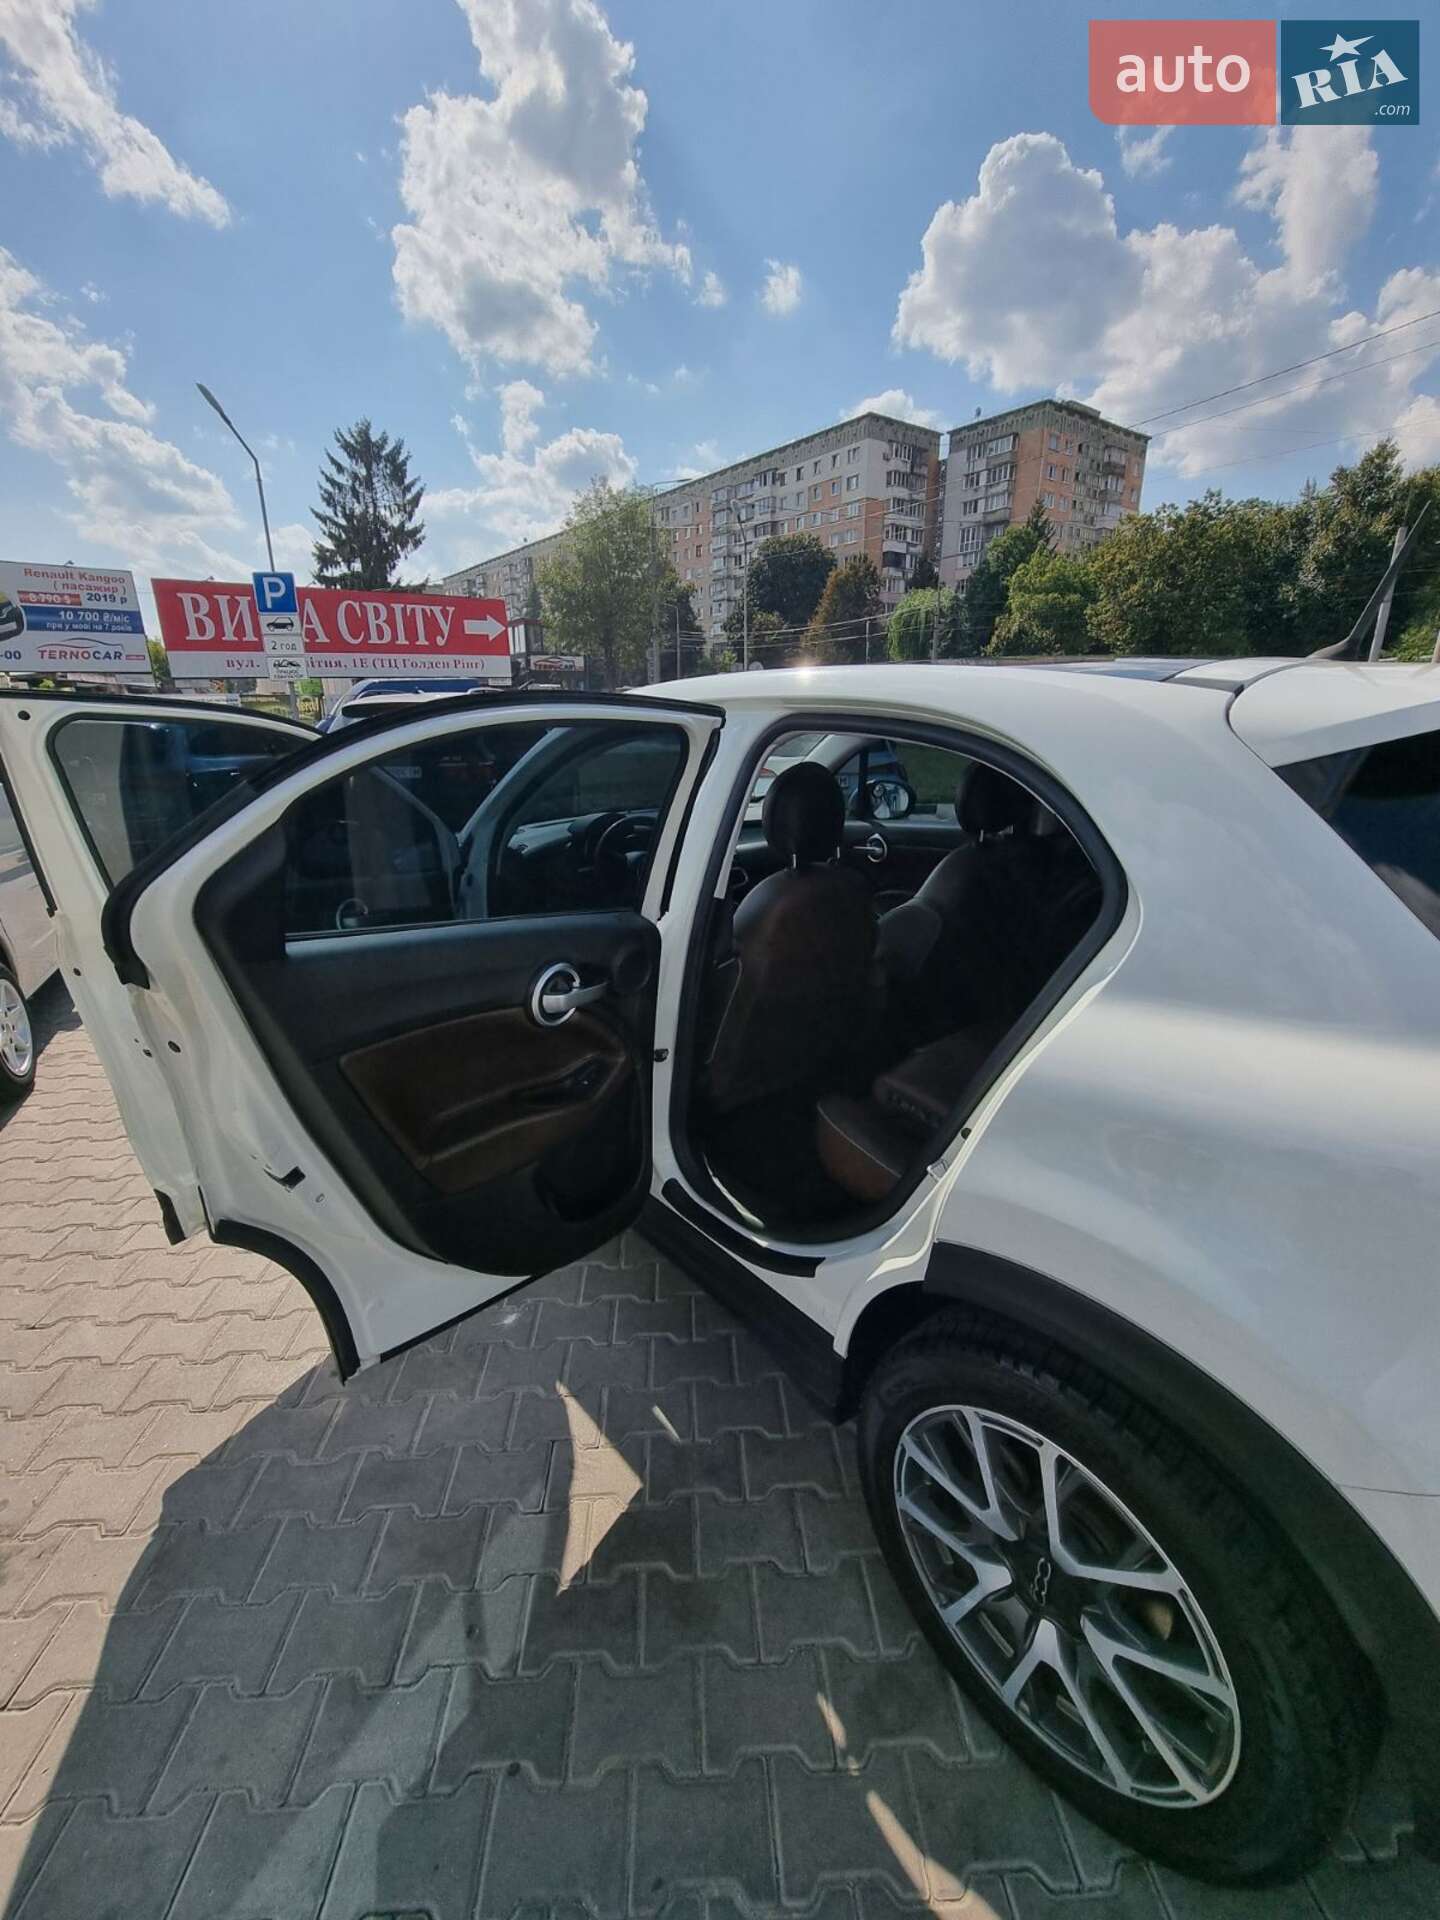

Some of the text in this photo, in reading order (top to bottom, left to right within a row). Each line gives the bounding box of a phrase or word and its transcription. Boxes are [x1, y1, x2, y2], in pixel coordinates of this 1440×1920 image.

[24, 568, 125, 584] Renault Kangoo
[86, 593, 116, 603] 2019
[262, 577, 286, 609] P
[59, 611, 73, 620] 10
[77, 611, 99, 621] 700
[176, 592, 455, 646] ВИА СВІТУ
[271, 641, 297, 651] 2 год
[38, 649, 122, 660] TERNOCAR
[226, 659, 260, 671] вул.
[304, 656, 348, 669] ітня,
